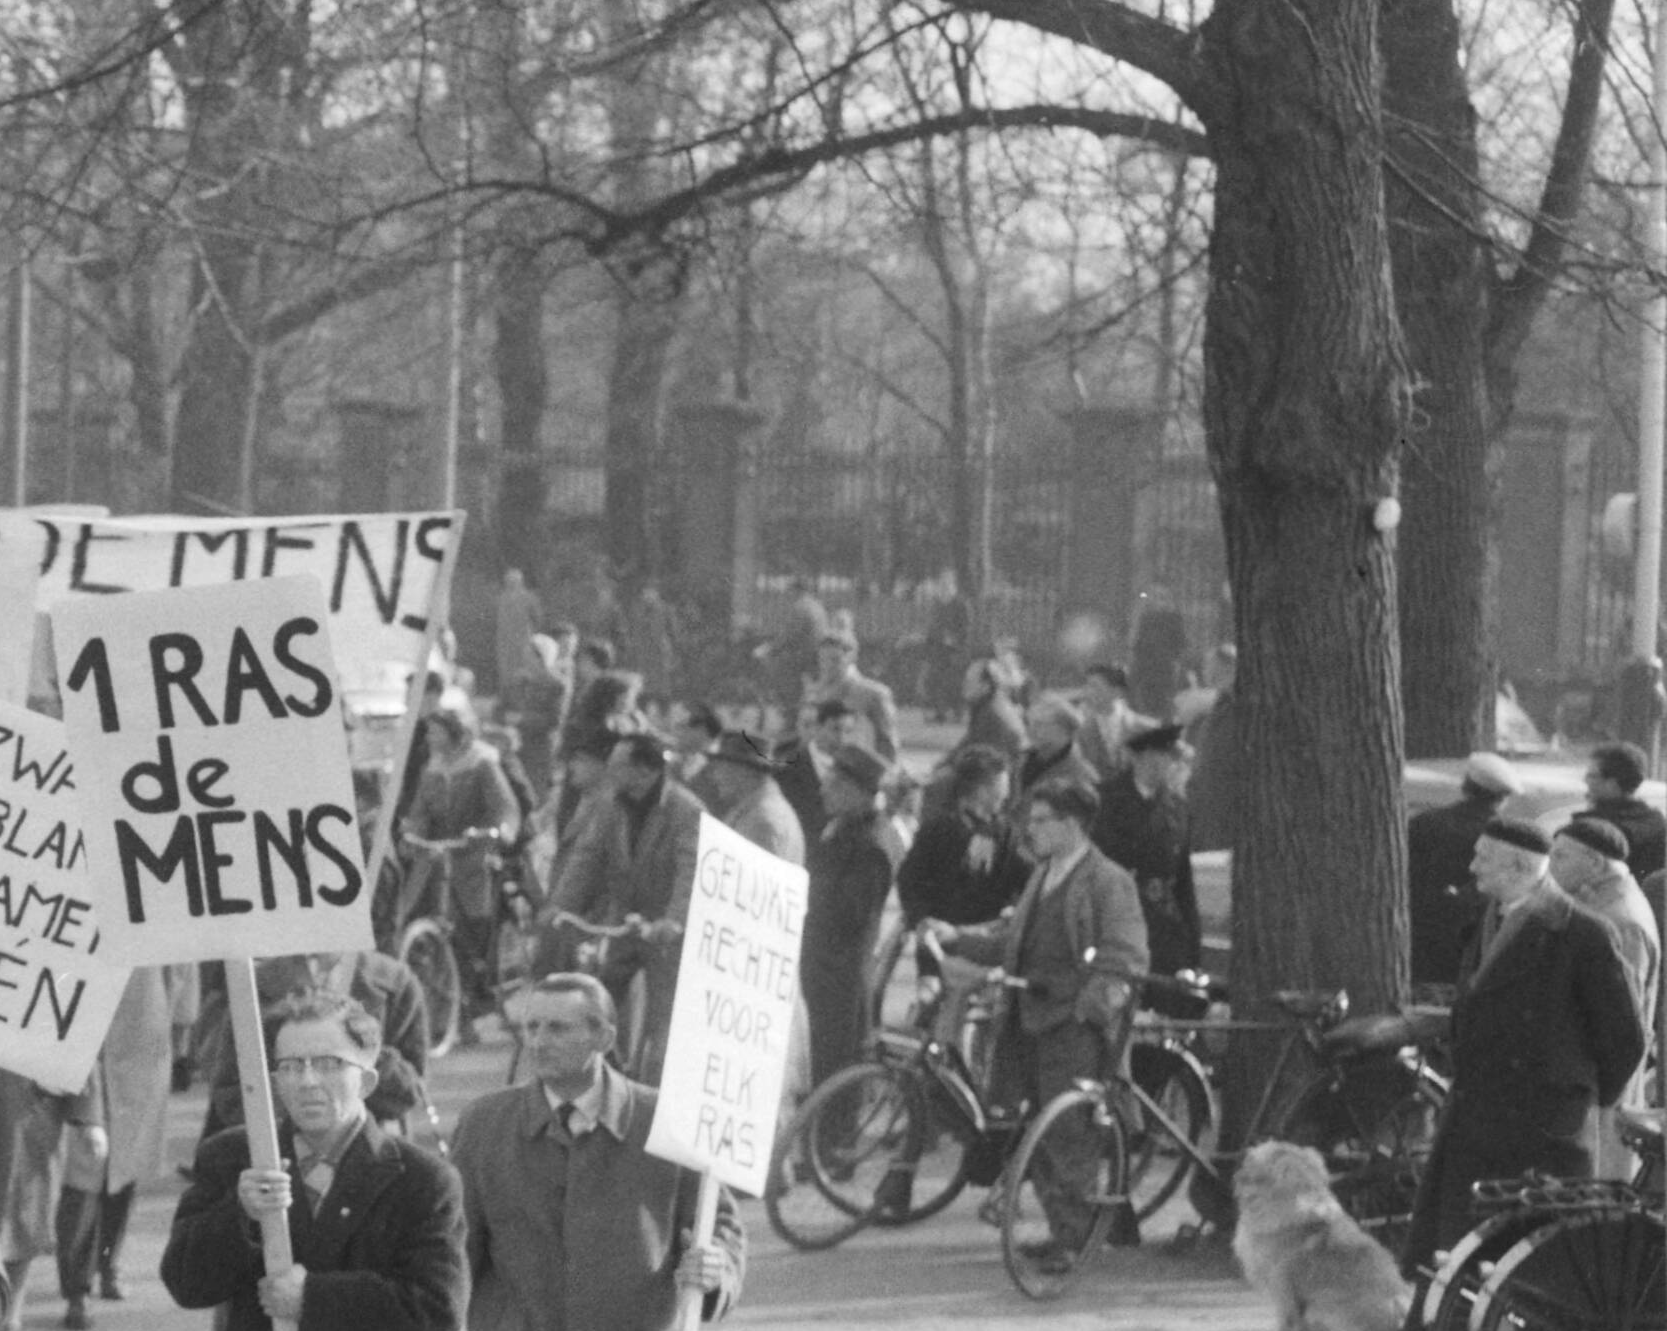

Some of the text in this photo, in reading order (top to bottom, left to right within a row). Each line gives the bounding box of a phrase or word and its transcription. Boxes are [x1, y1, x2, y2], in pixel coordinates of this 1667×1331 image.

[67, 616, 333, 733] 1 RAS
[120, 734, 236, 815] de
[114, 802, 363, 924] MENS
[704, 988, 772, 1056] VOOR
[702, 1052, 757, 1111] ELK
[694, 1103, 756, 1171] RAS
